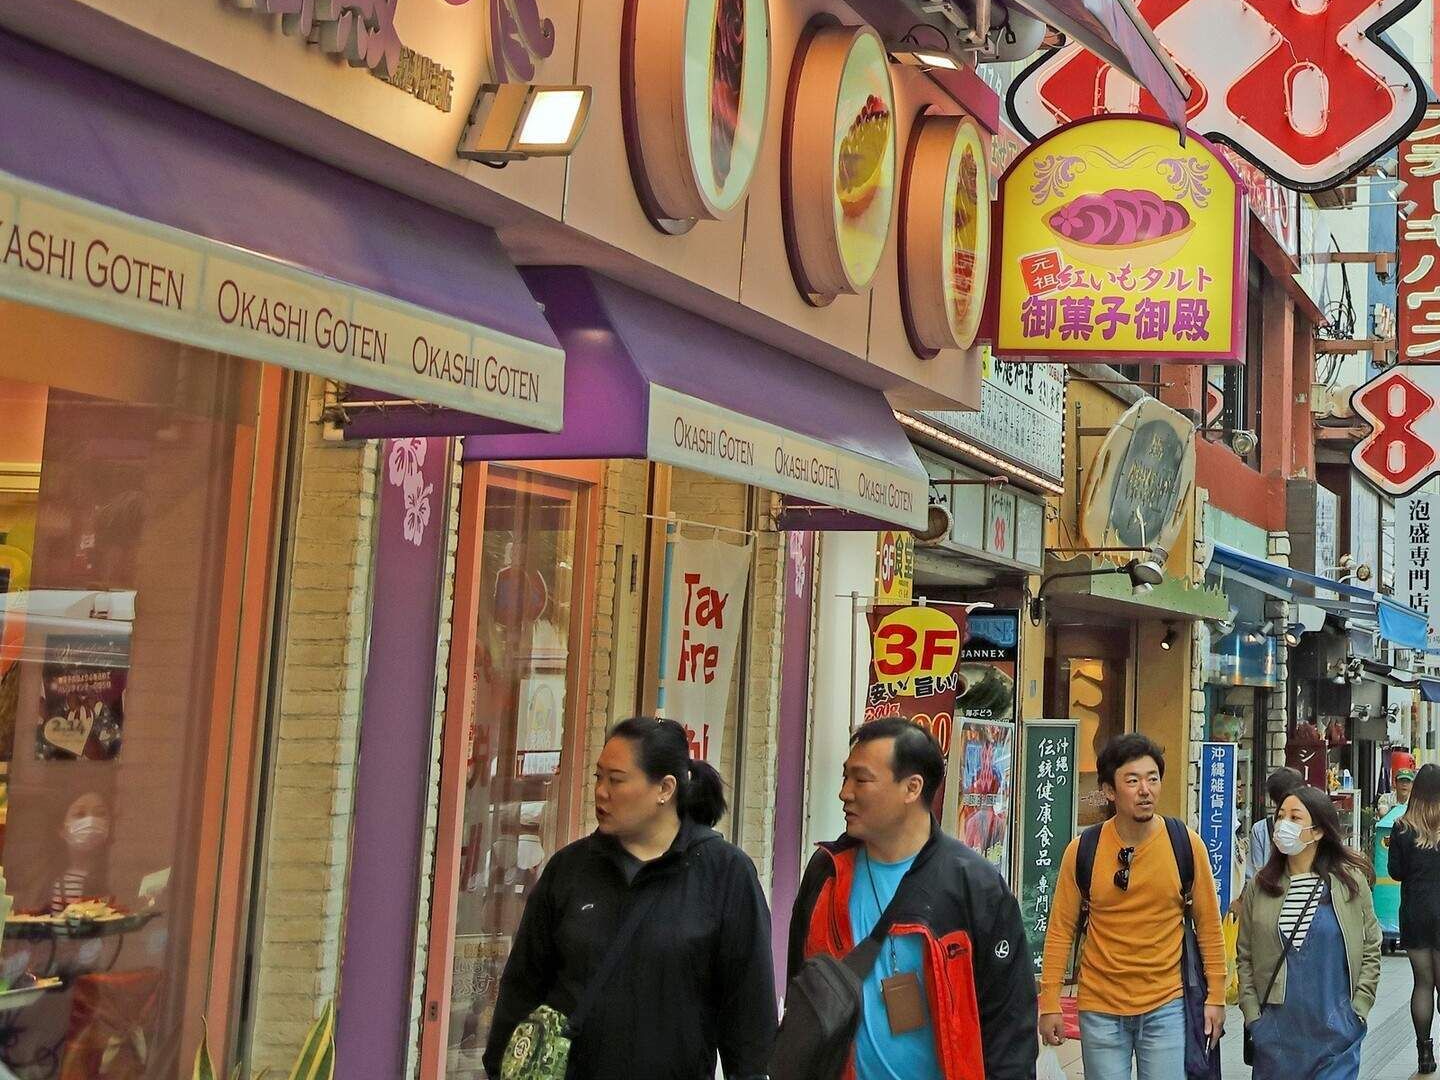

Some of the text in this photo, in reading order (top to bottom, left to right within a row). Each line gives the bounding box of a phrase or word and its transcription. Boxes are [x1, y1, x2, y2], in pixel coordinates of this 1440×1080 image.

[0, 222, 76, 281] ASHI
[1031, 257, 1060, 289] 元祖
[1055, 263, 1213, 293] 紅いもタルト
[1020, 296, 1211, 342] 御菓子御殿
[1408, 499, 1431, 614] 泡盛専門店
[684, 573, 729, 629] Tax
[876, 623, 958, 676] 3F
[966, 649, 1006, 659] ANNEX
[1055, 737, 1069, 786] 沖縄の
[1035, 738, 1056, 867] 伝統健康食品
